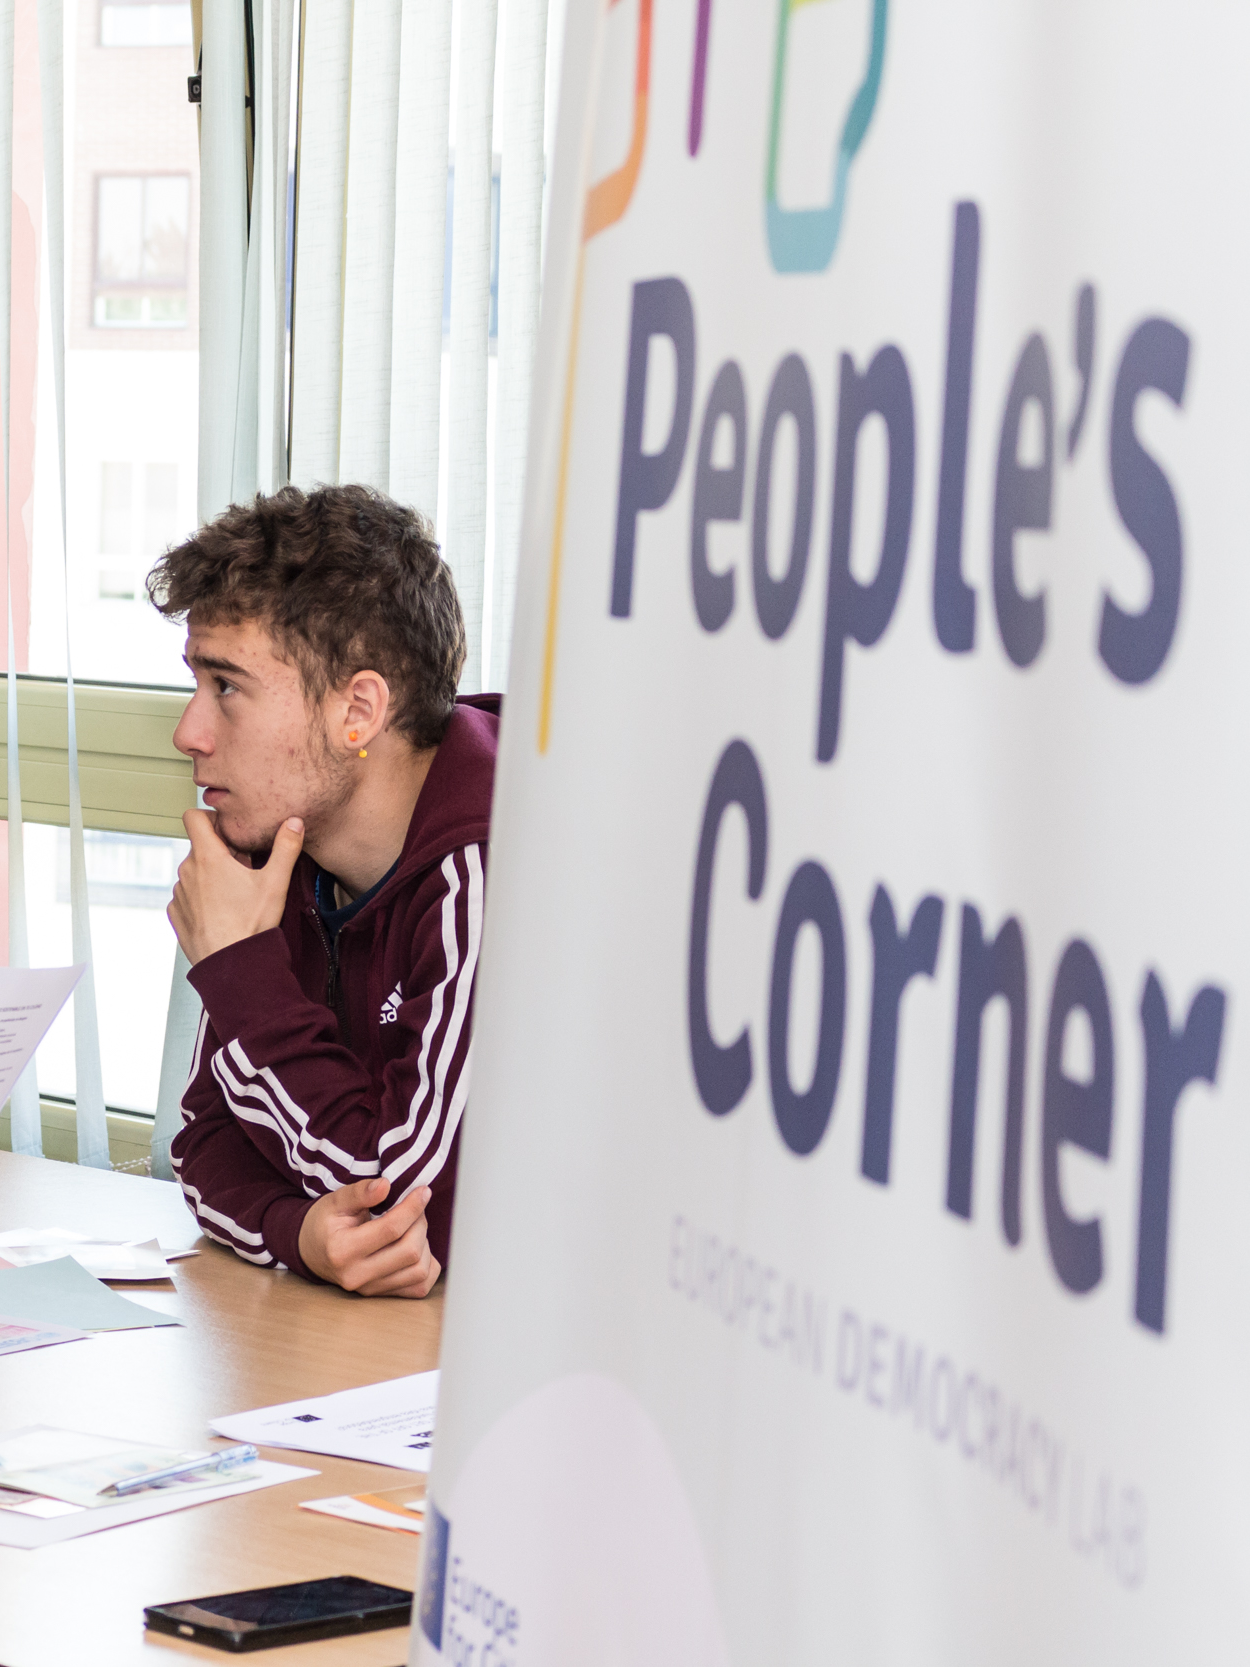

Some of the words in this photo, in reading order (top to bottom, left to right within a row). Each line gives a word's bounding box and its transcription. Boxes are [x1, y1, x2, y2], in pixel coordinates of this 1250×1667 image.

[610, 200, 1190, 763] People's
[688, 738, 1227, 1336] Corner
[451, 1556, 519, 1648] Europe
[668, 1214, 826, 1374] EUROPEAN
[836, 1306, 1063, 1528] DEMOCRACY
[1067, 1456, 1147, 1591] LAB
